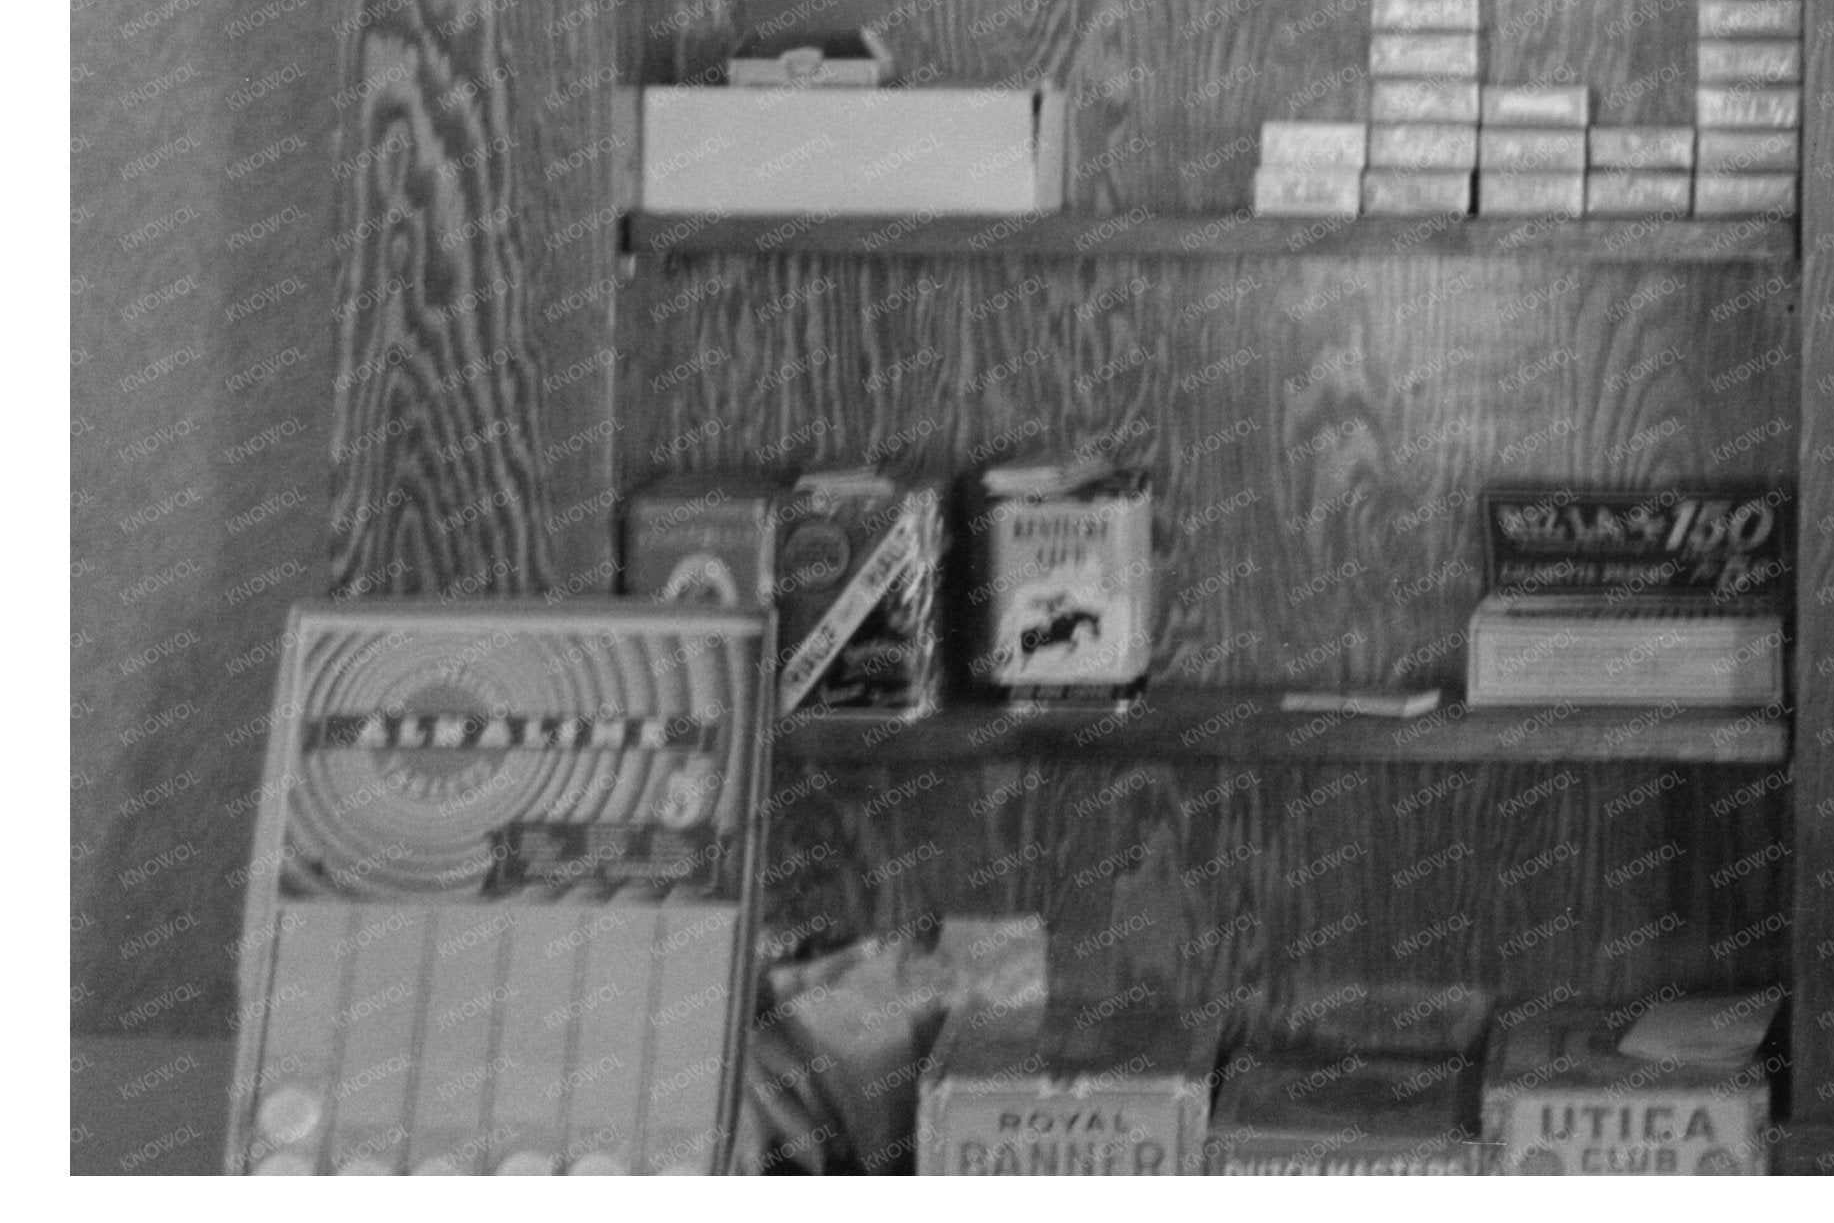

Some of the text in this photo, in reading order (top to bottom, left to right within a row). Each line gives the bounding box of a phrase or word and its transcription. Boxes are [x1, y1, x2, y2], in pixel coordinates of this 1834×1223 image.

[1664, 497, 1774, 551] 150
[998, 1110, 1130, 1135] ROYAL
[1541, 1103, 1717, 1142] UTICA
[1580, 1147, 1678, 1175] CLUB
